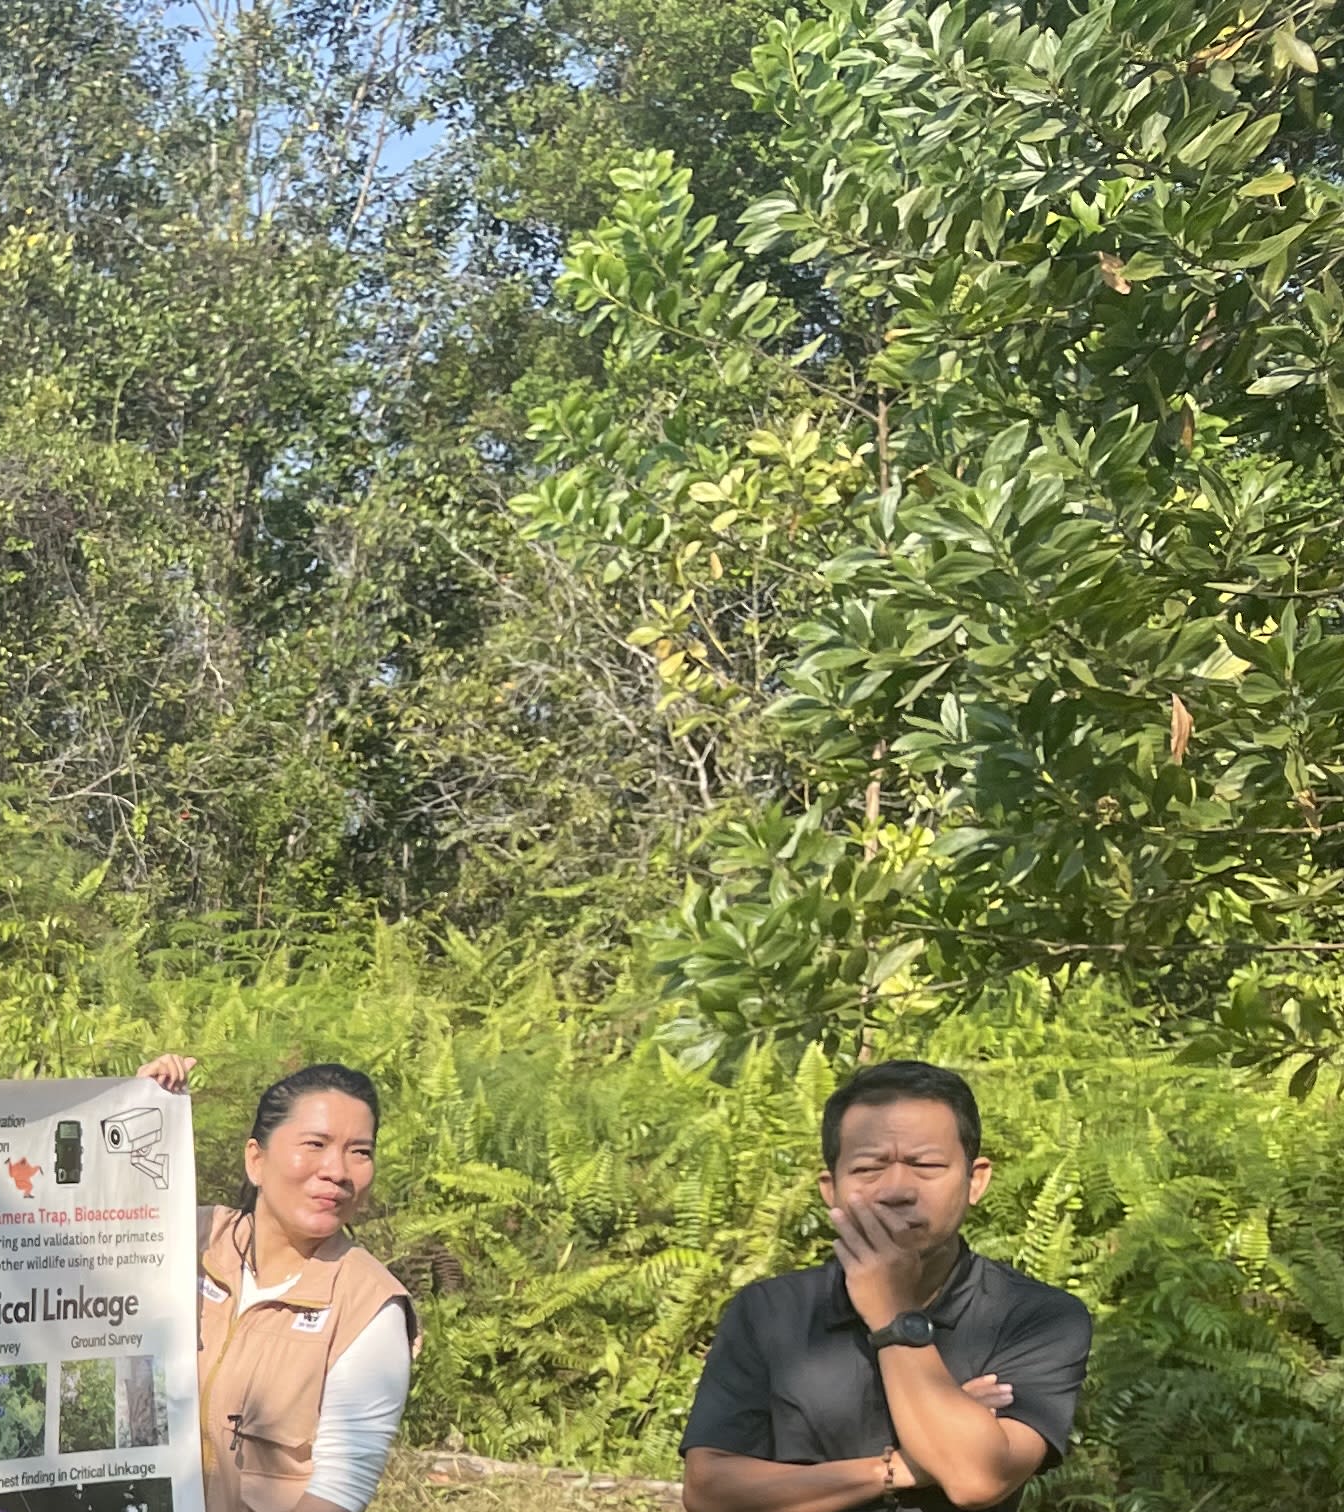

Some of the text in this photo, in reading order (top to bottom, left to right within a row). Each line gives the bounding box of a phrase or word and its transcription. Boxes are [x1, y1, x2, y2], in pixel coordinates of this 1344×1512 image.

[38, 1208, 71, 1226] Trap,
[21, 1234, 41, 1248] and
[43, 1232, 95, 1247] validation
[98, 1231, 112, 1245] for
[115, 1230, 164, 1246] primates
[26, 1255, 66, 1271] wildlife
[68, 1255, 95, 1270] using
[97, 1253, 113, 1267] the
[116, 1252, 164, 1270] pathway
[43, 1284, 139, 1326] Linkage
[71, 1332, 143, 1349] Ground Survey
[21, 1470, 56, 1490] finding
[58, 1468, 68, 1482] in
[70, 1464, 106, 1480] Critical
[108, 1461, 156, 1481] Linkage
